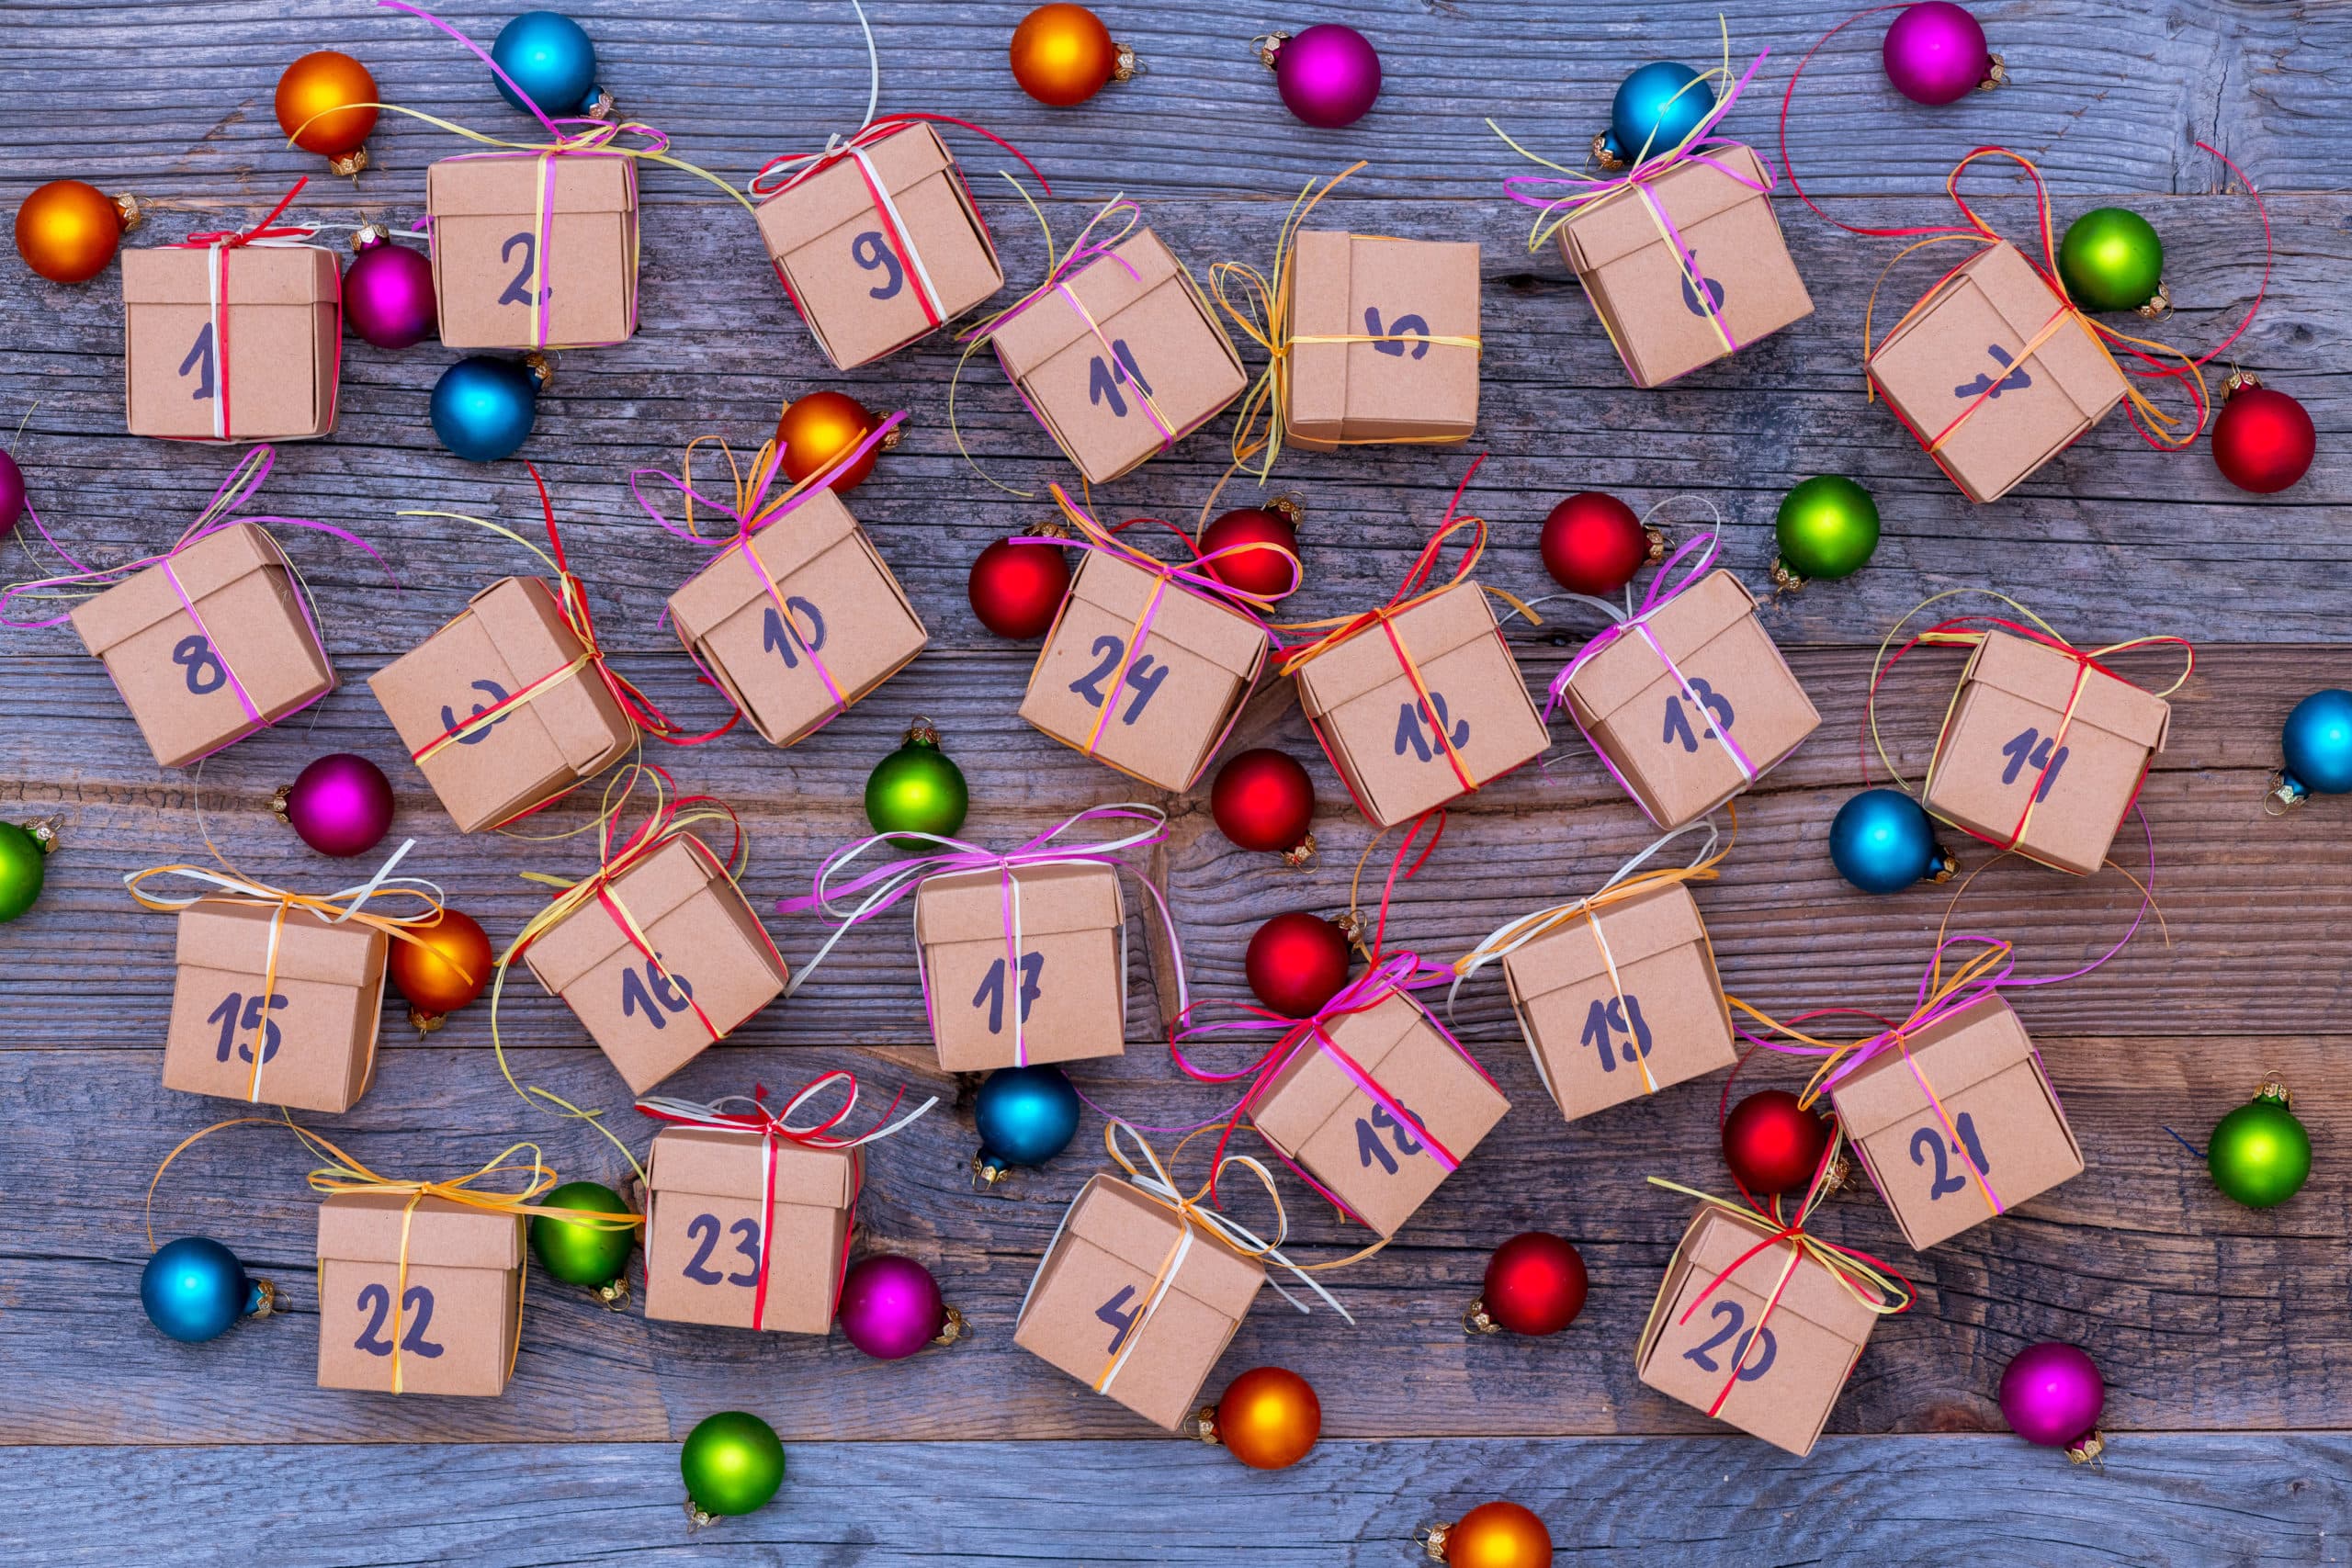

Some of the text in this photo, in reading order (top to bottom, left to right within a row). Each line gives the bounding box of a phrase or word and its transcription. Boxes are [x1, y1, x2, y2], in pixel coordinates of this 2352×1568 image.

[499, 233, 552, 306] 2
[853, 232, 903, 299] 9
[1682, 249, 1724, 317] 6
[179, 323, 215, 399] 1
[1365, 308, 1429, 359] 5
[1090, 340, 1152, 416] 11
[1955, 344, 2031, 398] 7
[174, 636, 226, 694] 8
[764, 597, 824, 668] 10
[442, 680, 508, 744] 3
[1069, 637, 1169, 725] 24
[1664, 678, 1734, 752] 13
[1395, 693, 1469, 761] 12
[2003, 728, 2069, 802] 14
[623, 953, 693, 1029] 16
[973, 952, 1044, 1032] 17
[209, 993, 288, 1064] 15
[1581, 996, 1653, 1072] 19
[1356, 1099, 1425, 1175] 18
[1910, 1112, 1989, 1200] 21
[684, 1214, 769, 1287] 23
[355, 1284, 444, 1358] 22
[1096, 1286, 1145, 1354] 4
[1683, 1302, 1777, 1381] 20
